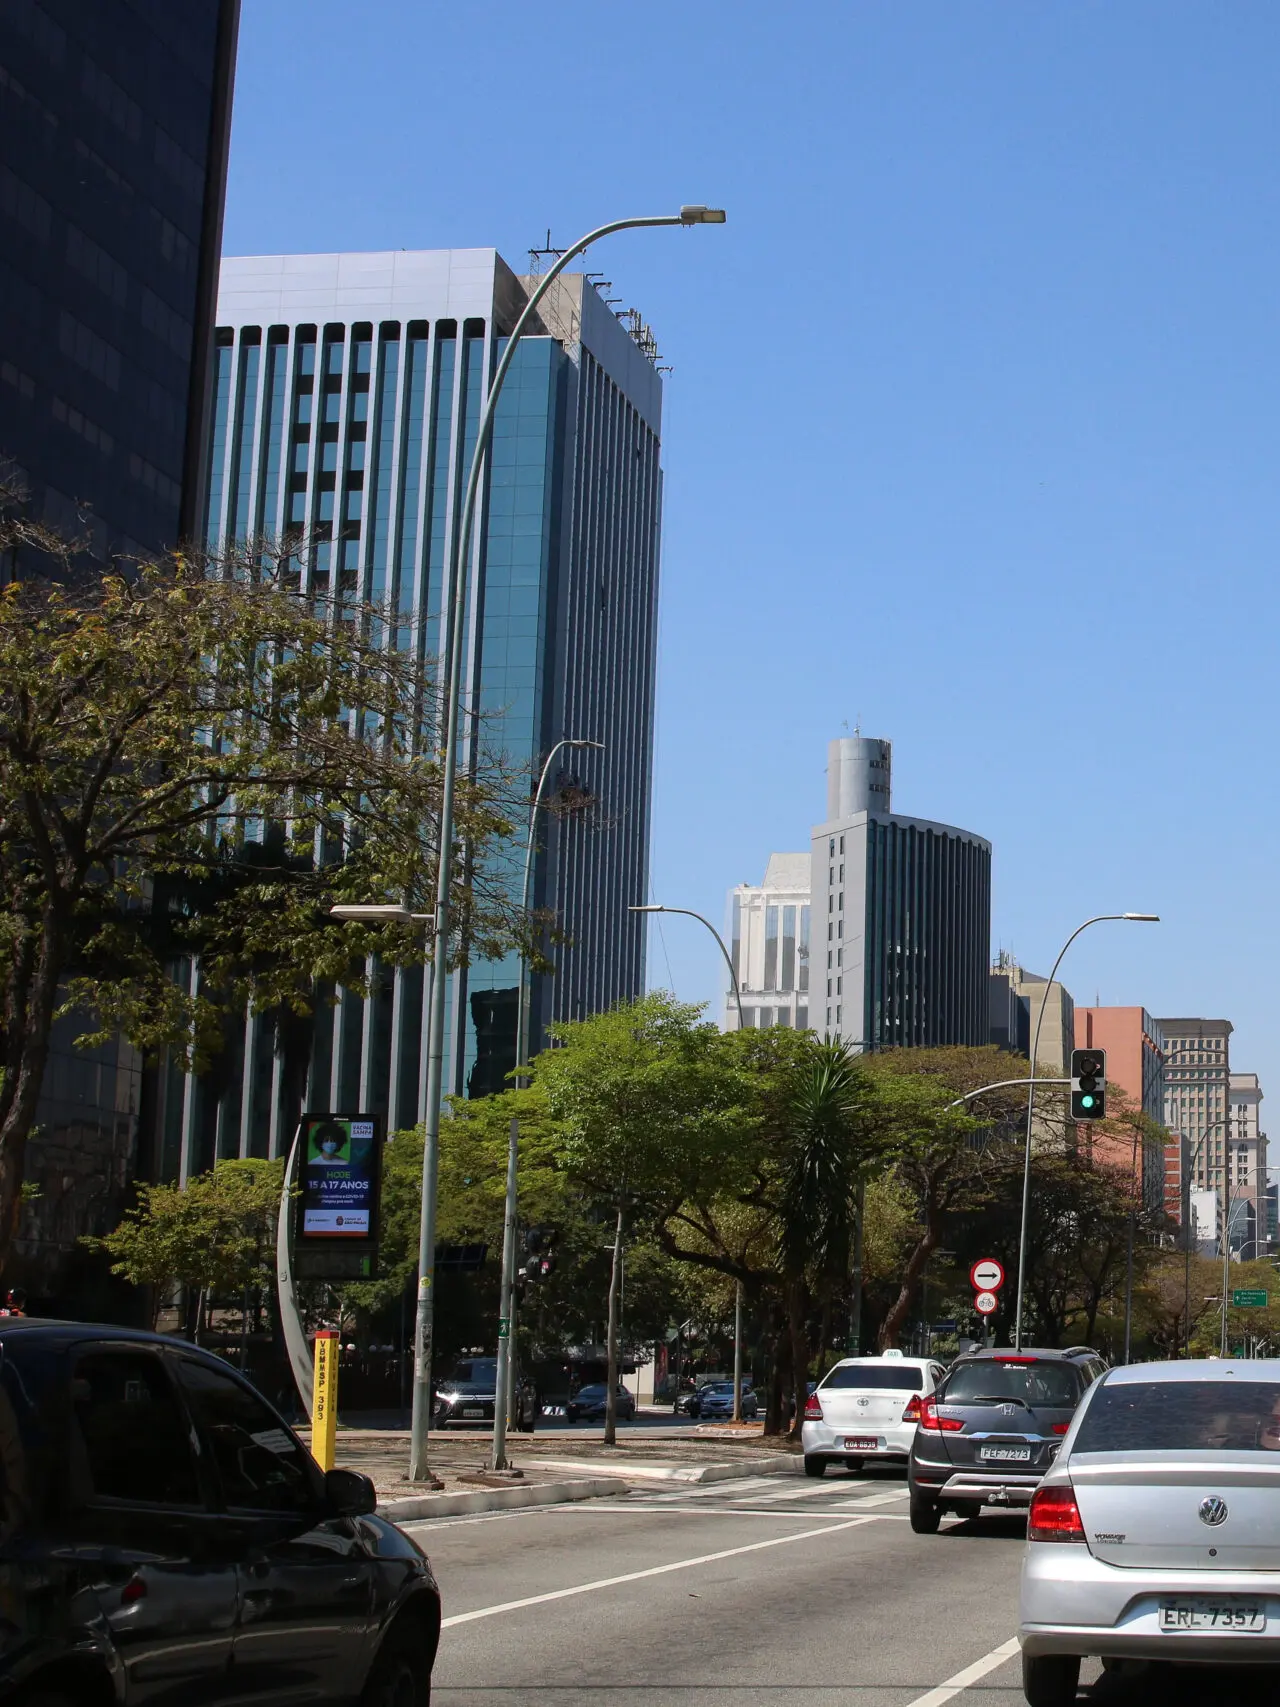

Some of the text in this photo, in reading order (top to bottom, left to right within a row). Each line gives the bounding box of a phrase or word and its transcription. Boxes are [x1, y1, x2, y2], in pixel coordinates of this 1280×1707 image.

[326, 1171, 351, 1179] HOJE
[308, 1181, 369, 1189] 15 A 17 ANOS
